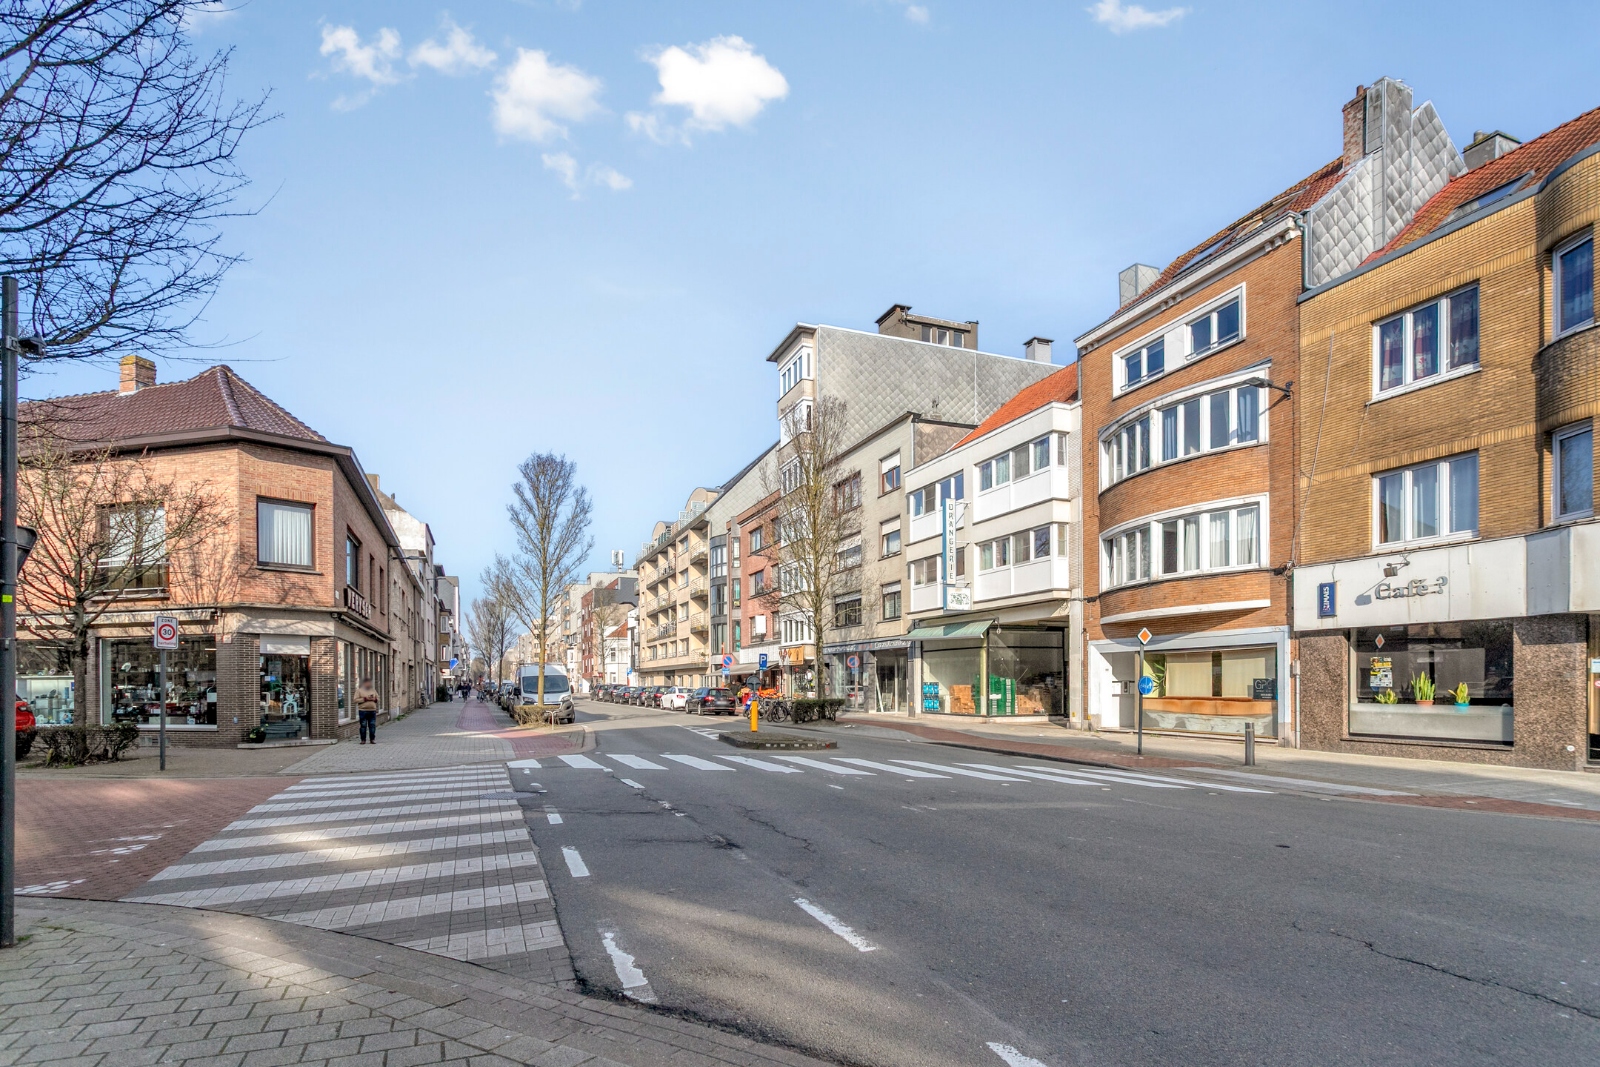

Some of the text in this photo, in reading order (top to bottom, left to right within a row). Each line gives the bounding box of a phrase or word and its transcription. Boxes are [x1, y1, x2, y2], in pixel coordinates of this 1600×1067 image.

[1374, 577, 1429, 600] Café
[162, 628, 172, 636] 30
[760, 655, 767, 665] P
